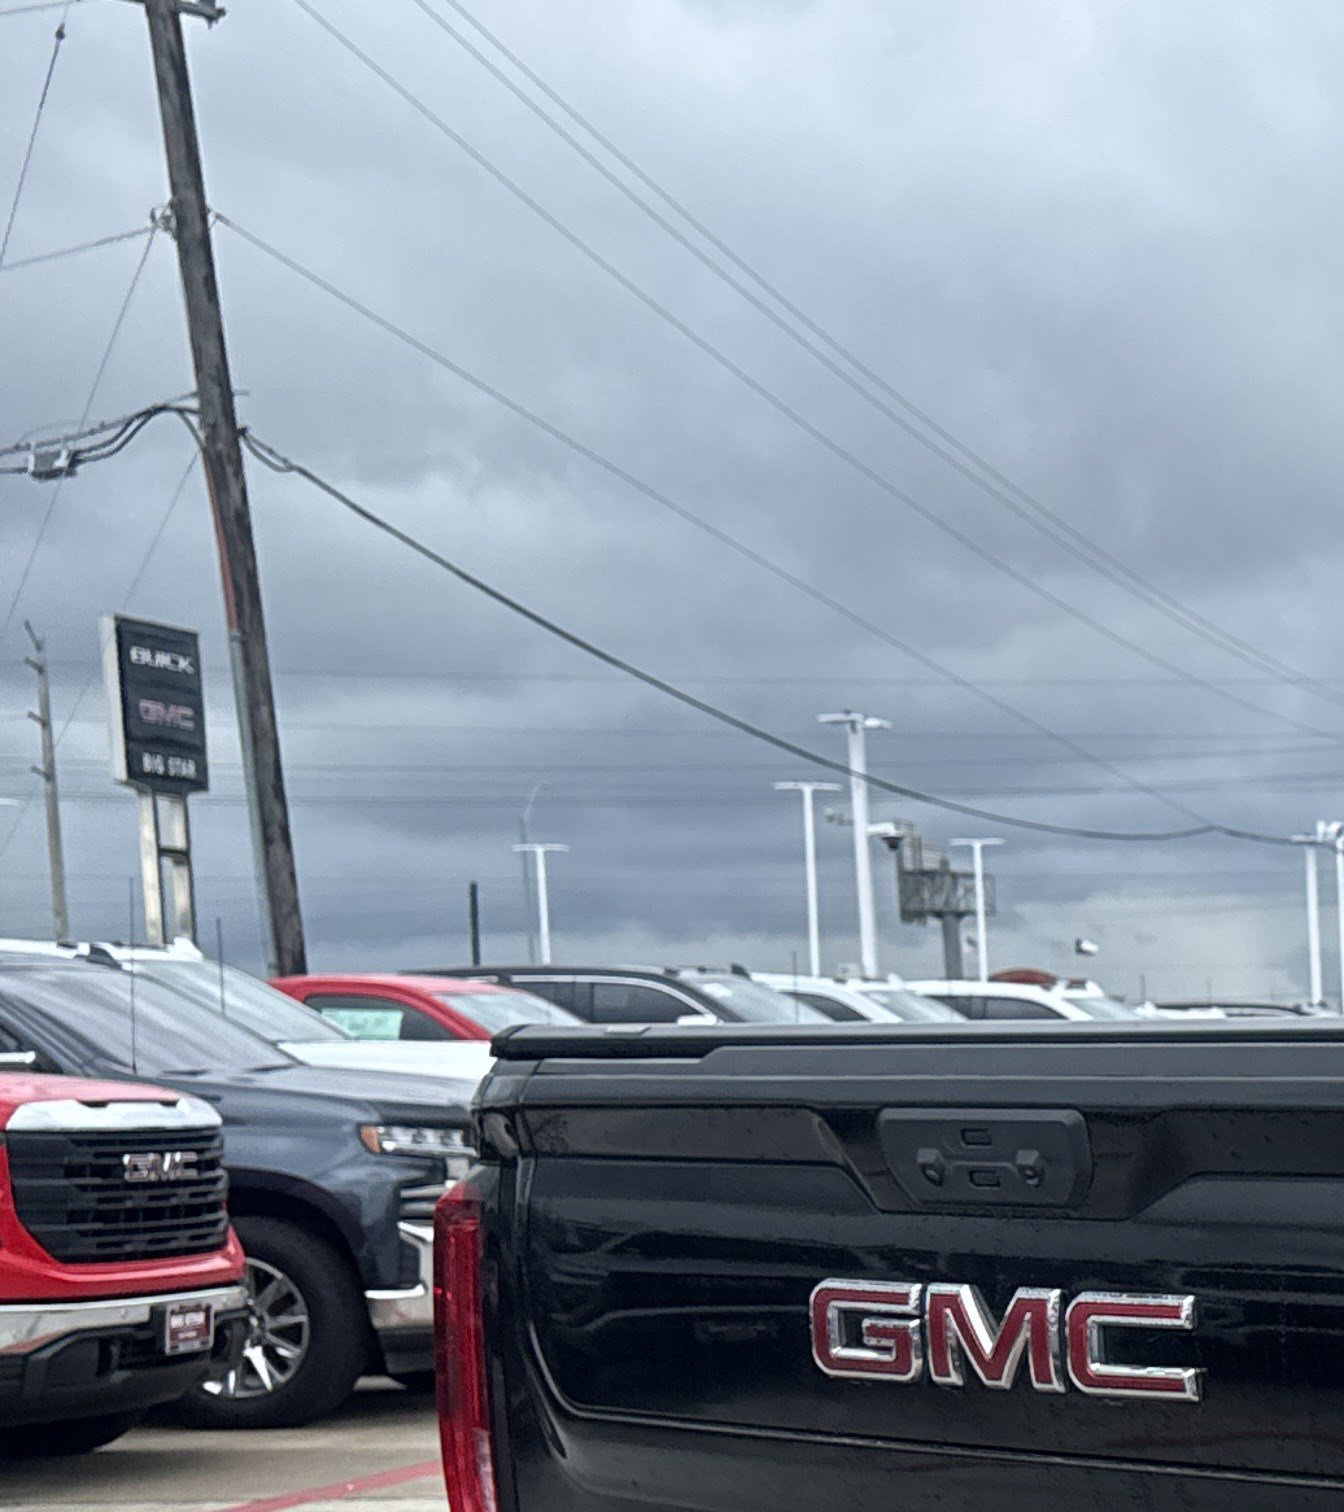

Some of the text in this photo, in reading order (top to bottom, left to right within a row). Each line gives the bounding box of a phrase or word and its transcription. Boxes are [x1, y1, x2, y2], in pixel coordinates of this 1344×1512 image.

[129, 645, 195, 675] BUICK
[138, 699, 196, 731] GMC
[122, 1151, 199, 1182] GMC
[809, 1277, 1201, 1402] GMC
